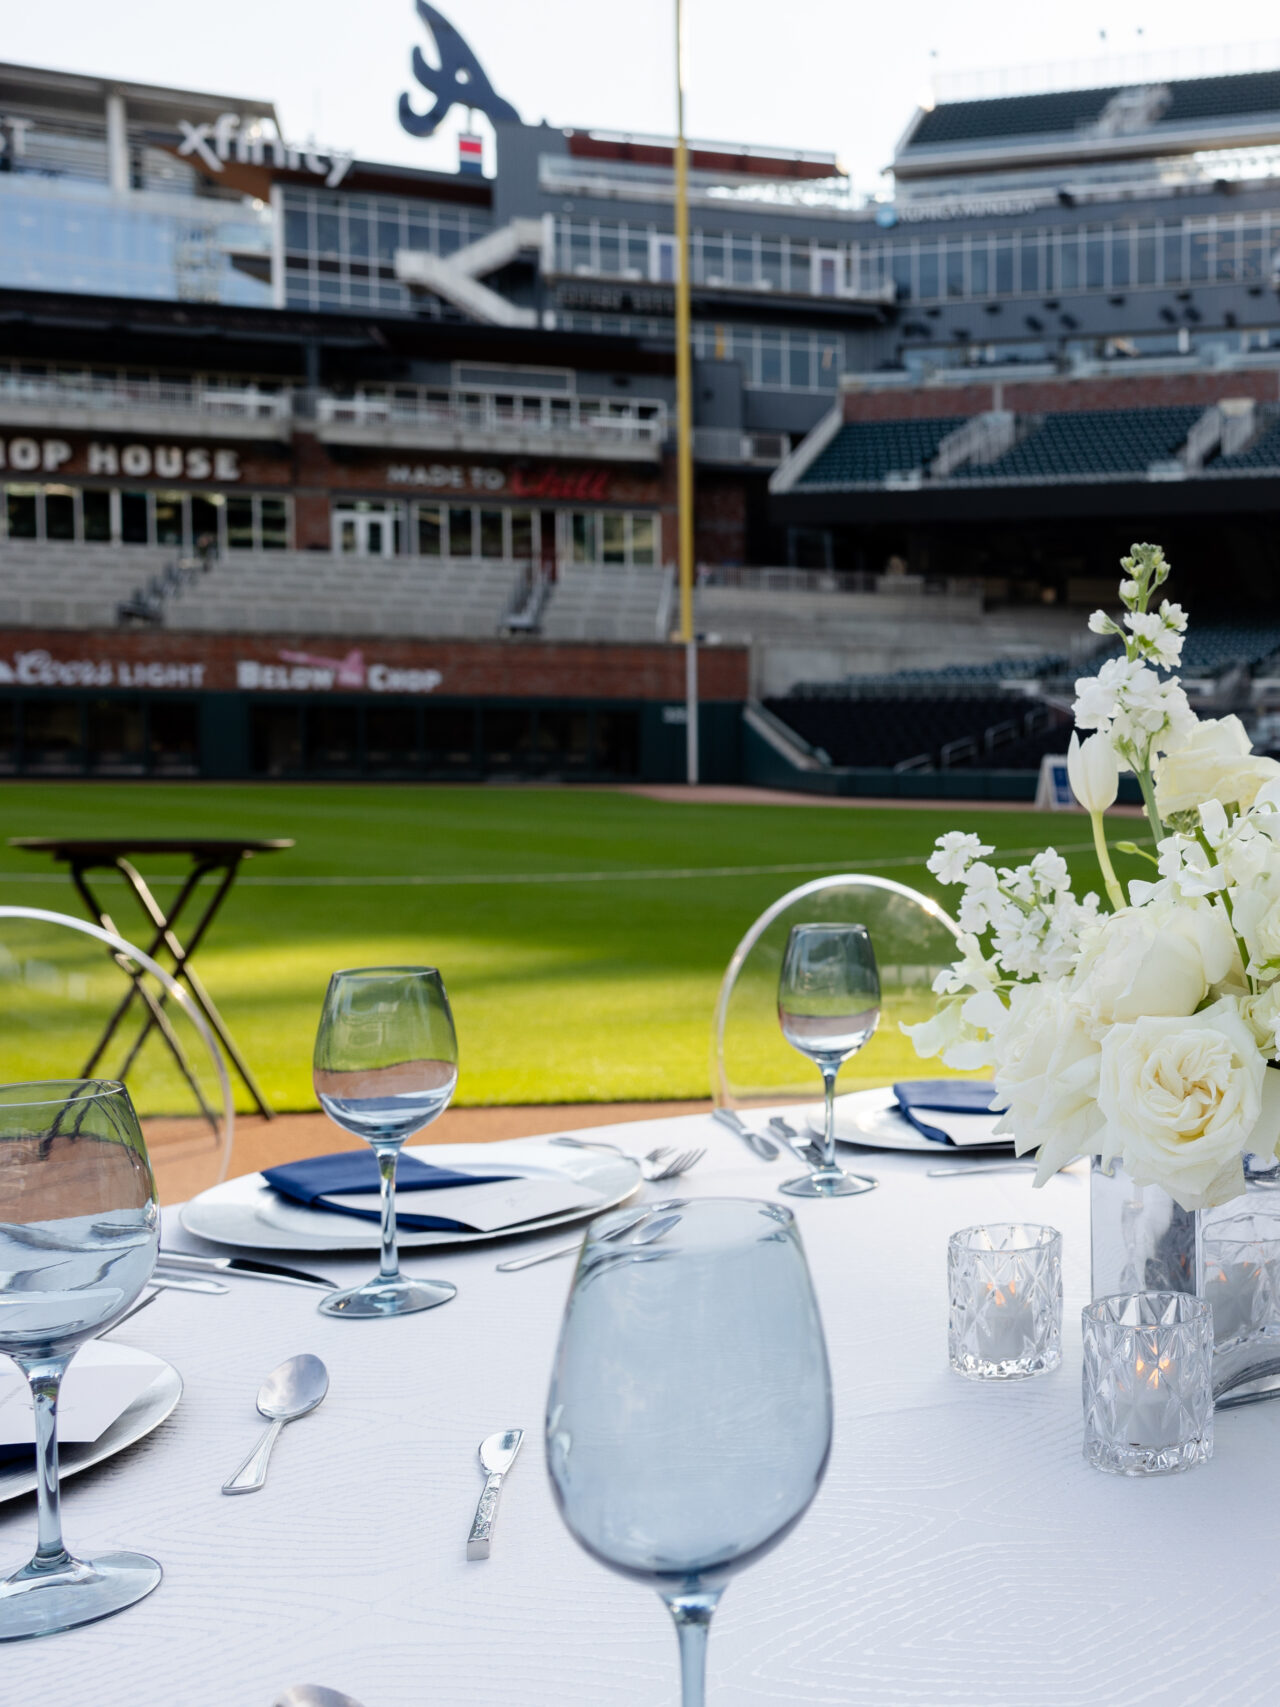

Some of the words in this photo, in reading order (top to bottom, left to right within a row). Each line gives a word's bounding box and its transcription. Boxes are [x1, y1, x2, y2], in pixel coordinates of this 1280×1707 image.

[176, 112, 354, 188] xfinity
[0, 437, 72, 472] OP
[86, 441, 241, 482] HOUSE
[386, 464, 465, 488] MADE
[470, 466, 505, 491] TO
[118, 661, 206, 688] LIGHT
